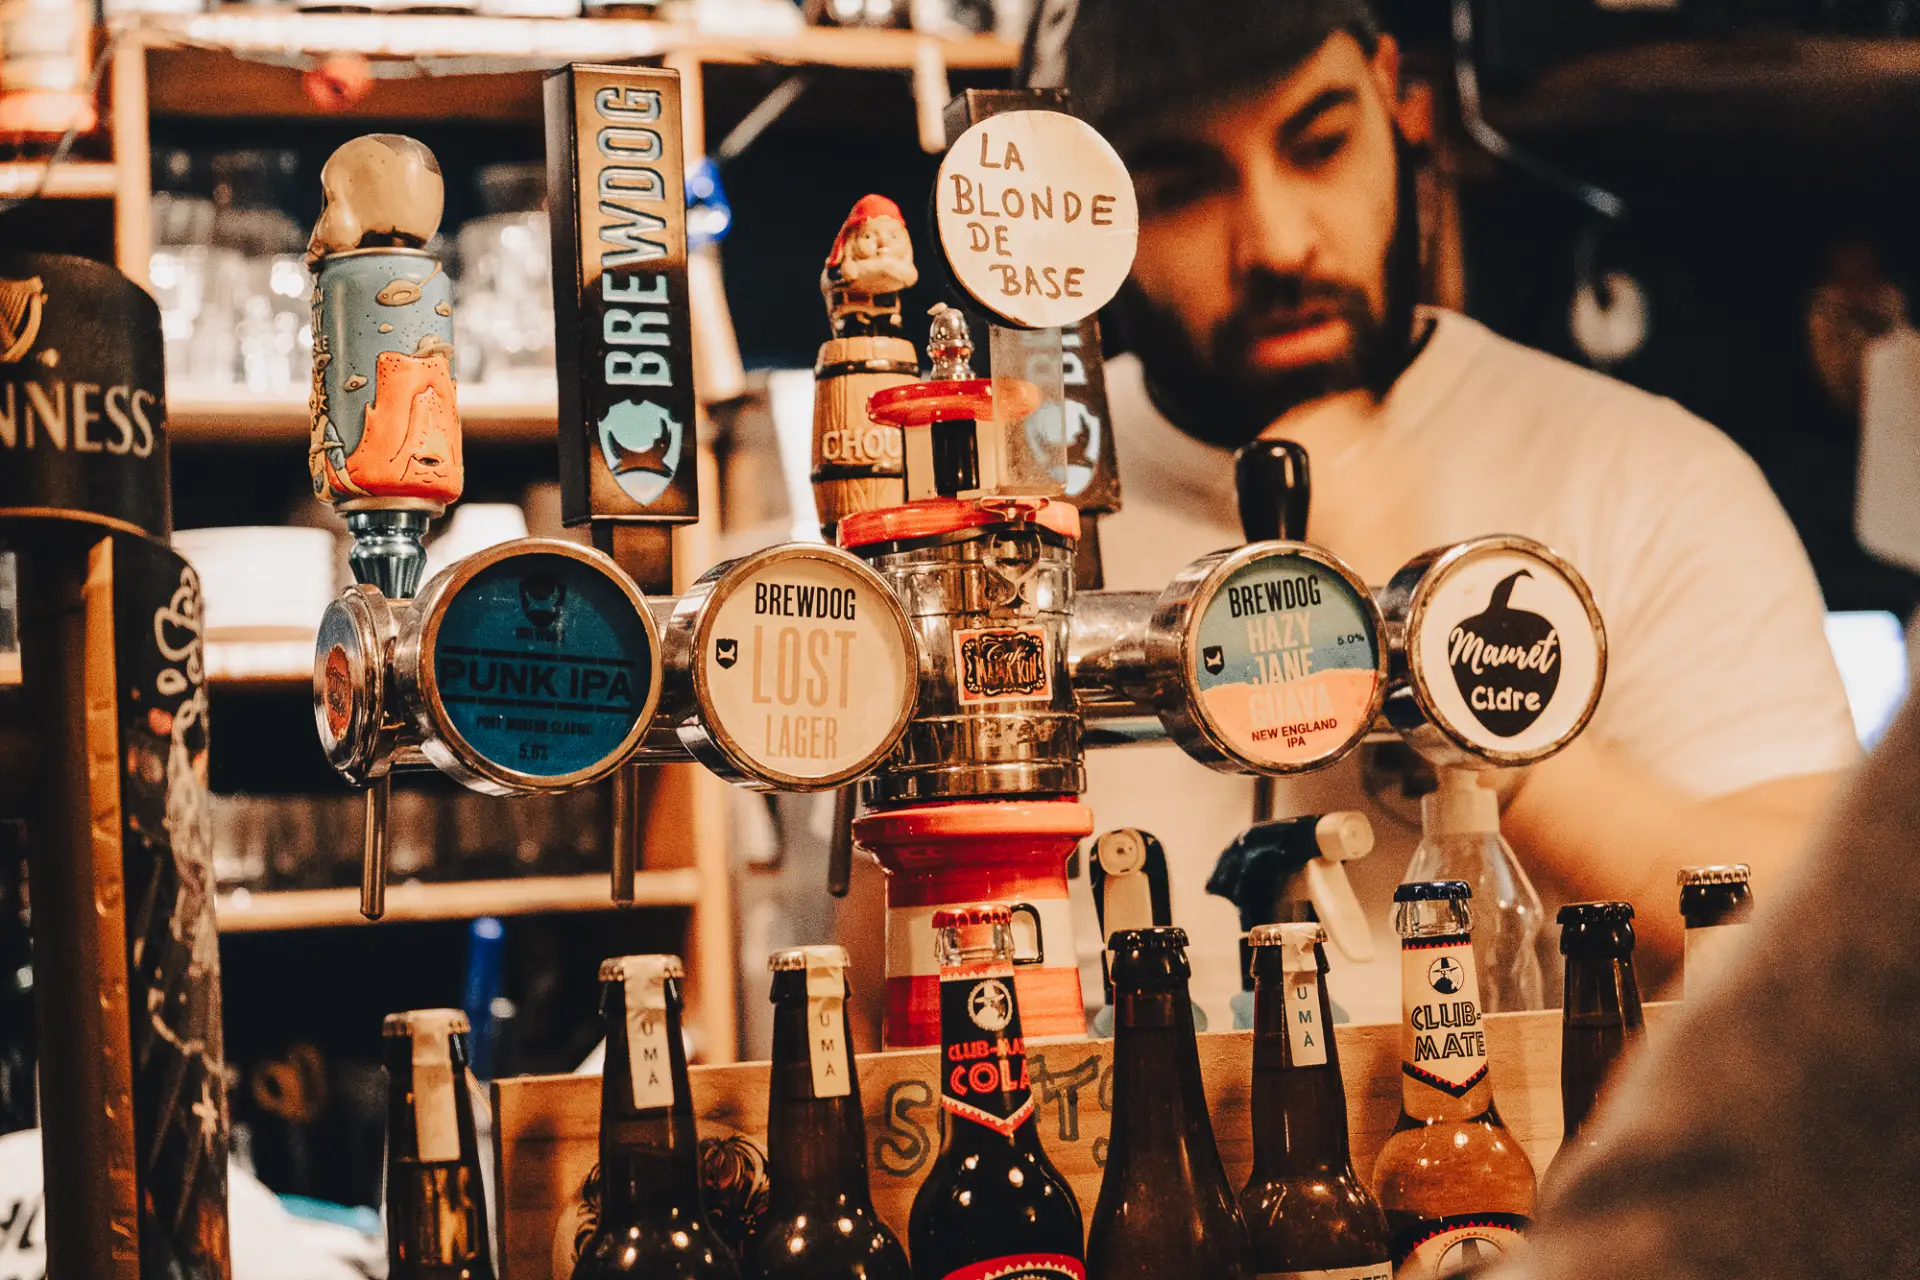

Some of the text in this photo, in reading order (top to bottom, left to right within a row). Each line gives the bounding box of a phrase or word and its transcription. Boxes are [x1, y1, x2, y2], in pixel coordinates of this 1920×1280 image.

[979, 132, 1025, 172] LA
[949, 174, 1117, 226] BLONDE
[594, 85, 674, 387] BREWDOG
[966, 221, 1013, 256] DE
[989, 264, 1086, 300] BASE
[754, 582, 856, 621] BREWDOG
[1228, 575, 1322, 618] BREWDOG
[1246, 611, 1311, 653] HAZY
[1450, 627, 1557, 675] Mauret
[751, 624, 857, 709] LOST
[981, 641, 1029, 666] Café
[1252, 648, 1313, 687] JANE
[438, 658, 634, 702] PUNK IPA
[1471, 685, 1541, 712] Cidre
[765, 713, 838, 760] LAGER
[1251, 718, 1338, 742] NEW ENGLAND
[1287, 736, 1306, 748] IPA
[1414, 1031, 1486, 1062] MATE
[950, 1058, 1031, 1097] COLA
